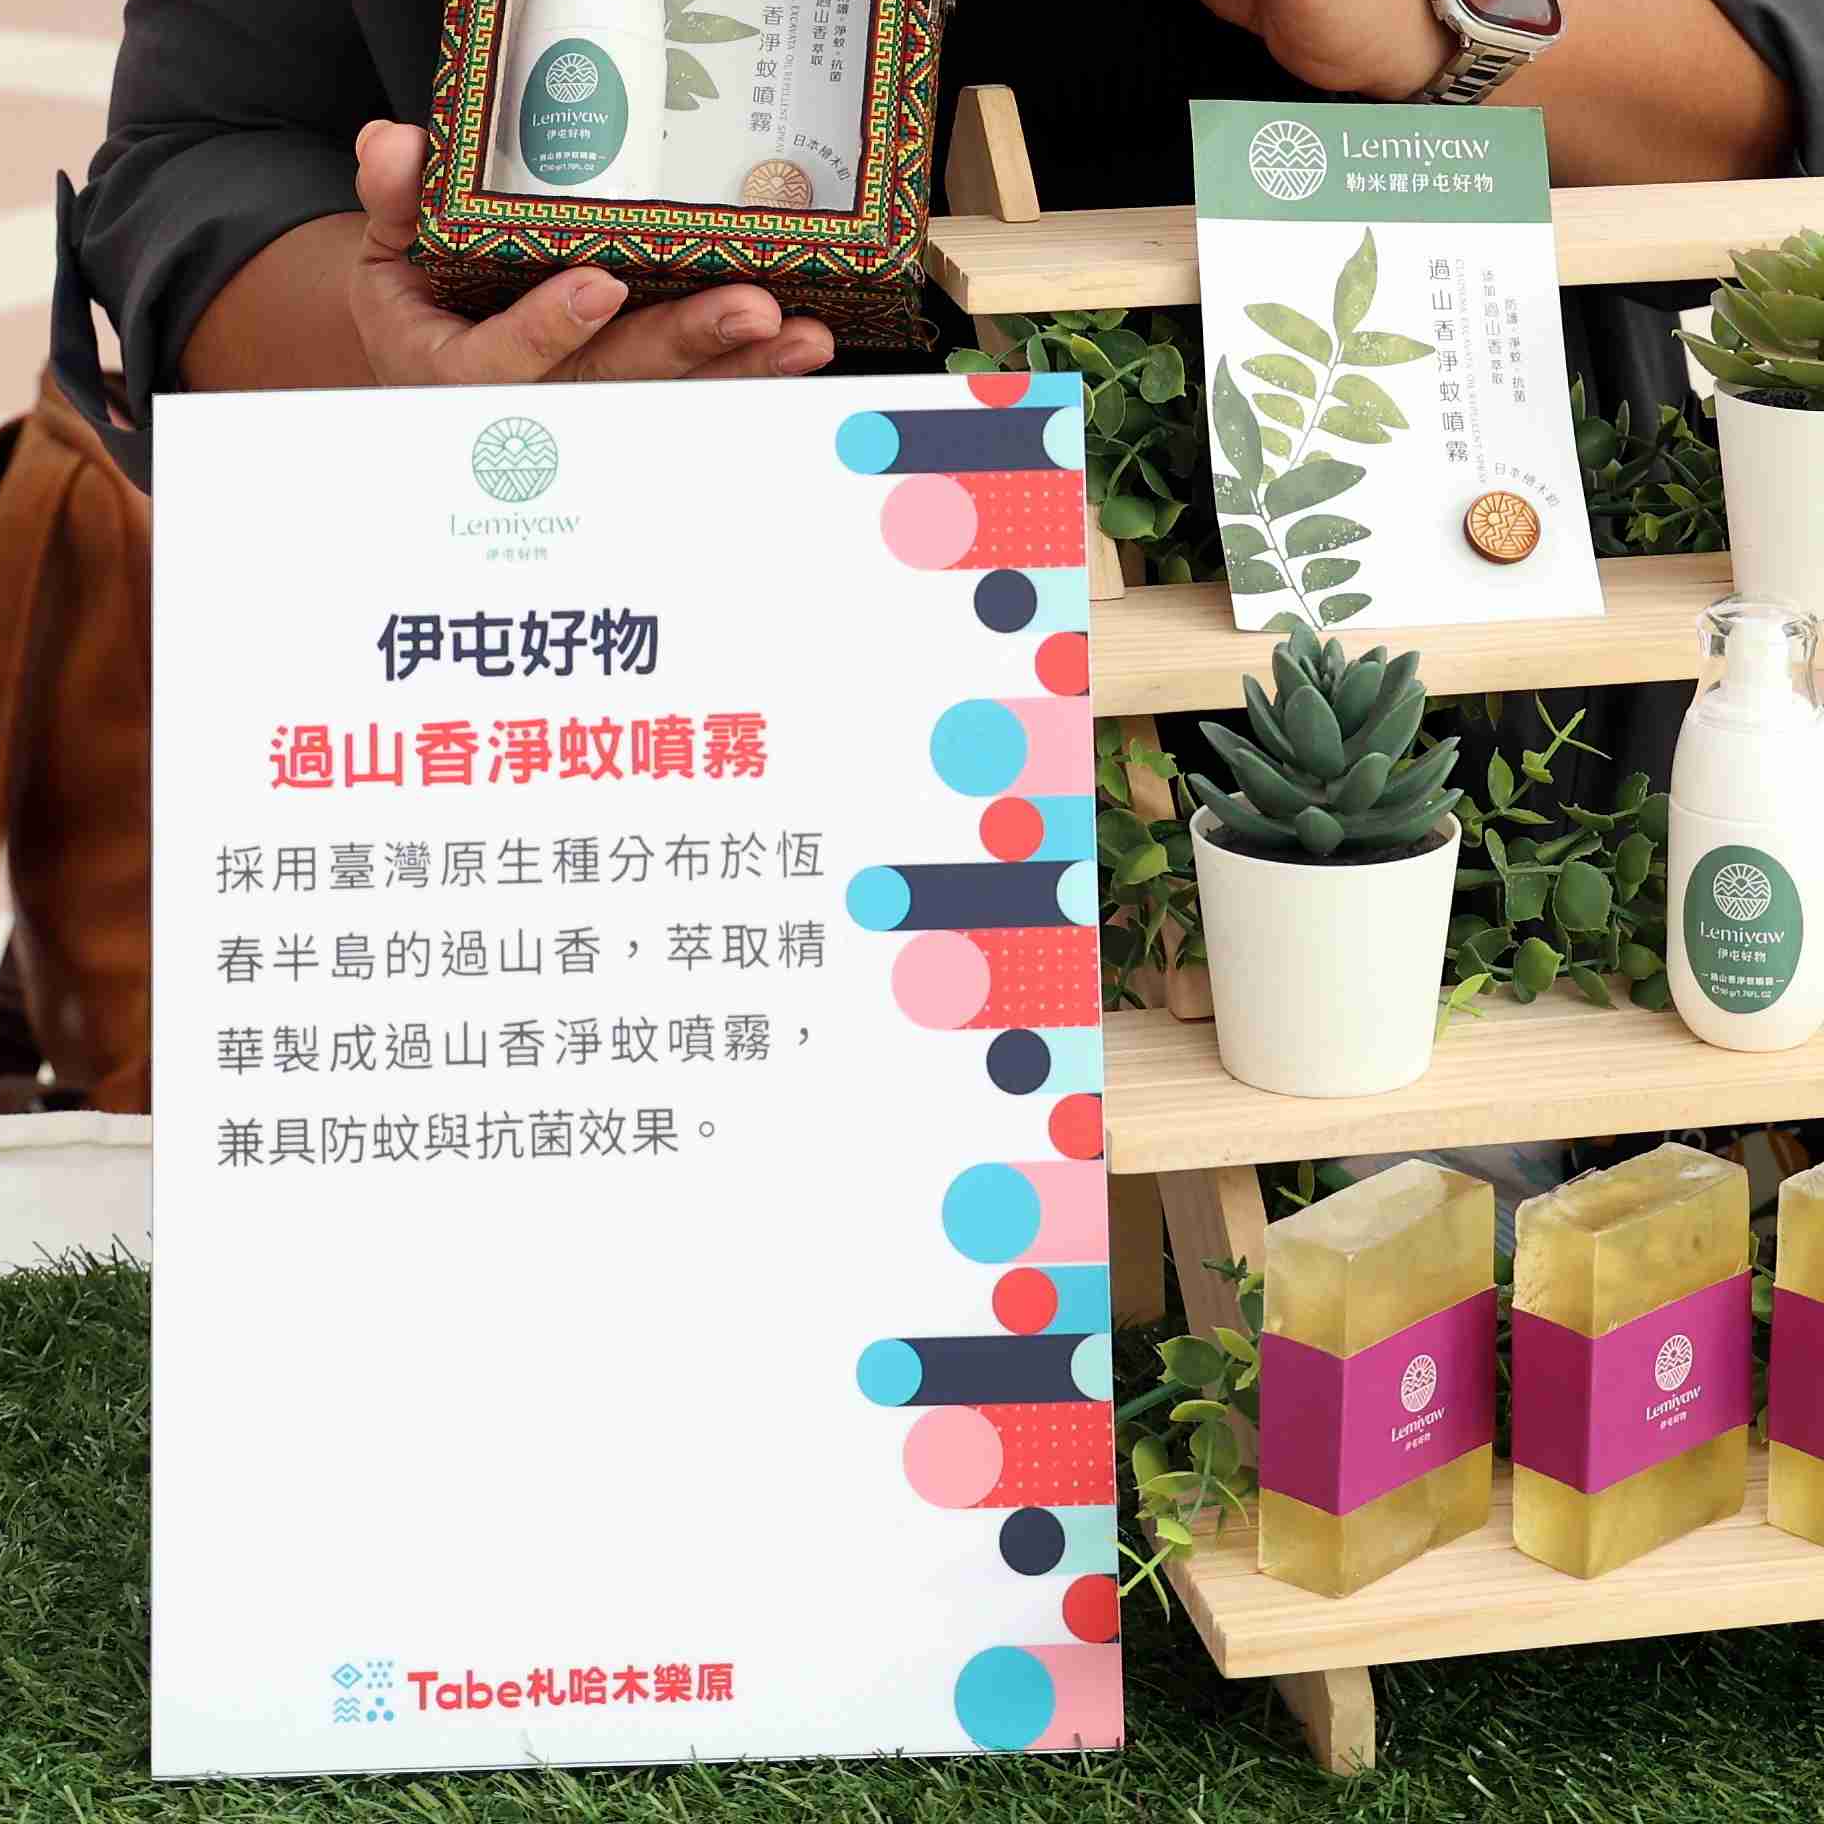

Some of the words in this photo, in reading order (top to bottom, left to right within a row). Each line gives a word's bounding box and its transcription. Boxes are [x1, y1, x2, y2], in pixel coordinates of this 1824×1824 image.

[532, 108, 609, 128] Lemiyaw
[1342, 131, 1490, 167] Lemiyaw
[1428, 258, 1469, 463] 過山香淨蚊噴霧
[450, 512, 580, 541] Lemiyaw
[376, 607, 659, 682] 伊屯好物
[269, 712, 769, 790] 過山香淨蚊噴霧
[216, 830, 825, 894] 採用臺灣原生種分布於恆
[216, 920, 826, 984] 春半島的過山香，萃取精
[1700, 920, 1785, 947] Lemiyaw
[216, 1014, 810, 1076] 華製成過山香淨蚊噴霧，
[217, 1107, 716, 1167] 兼具防蚊與抗菌效果。
[407, 1661, 735, 1712] Tabe札哈木樂原
